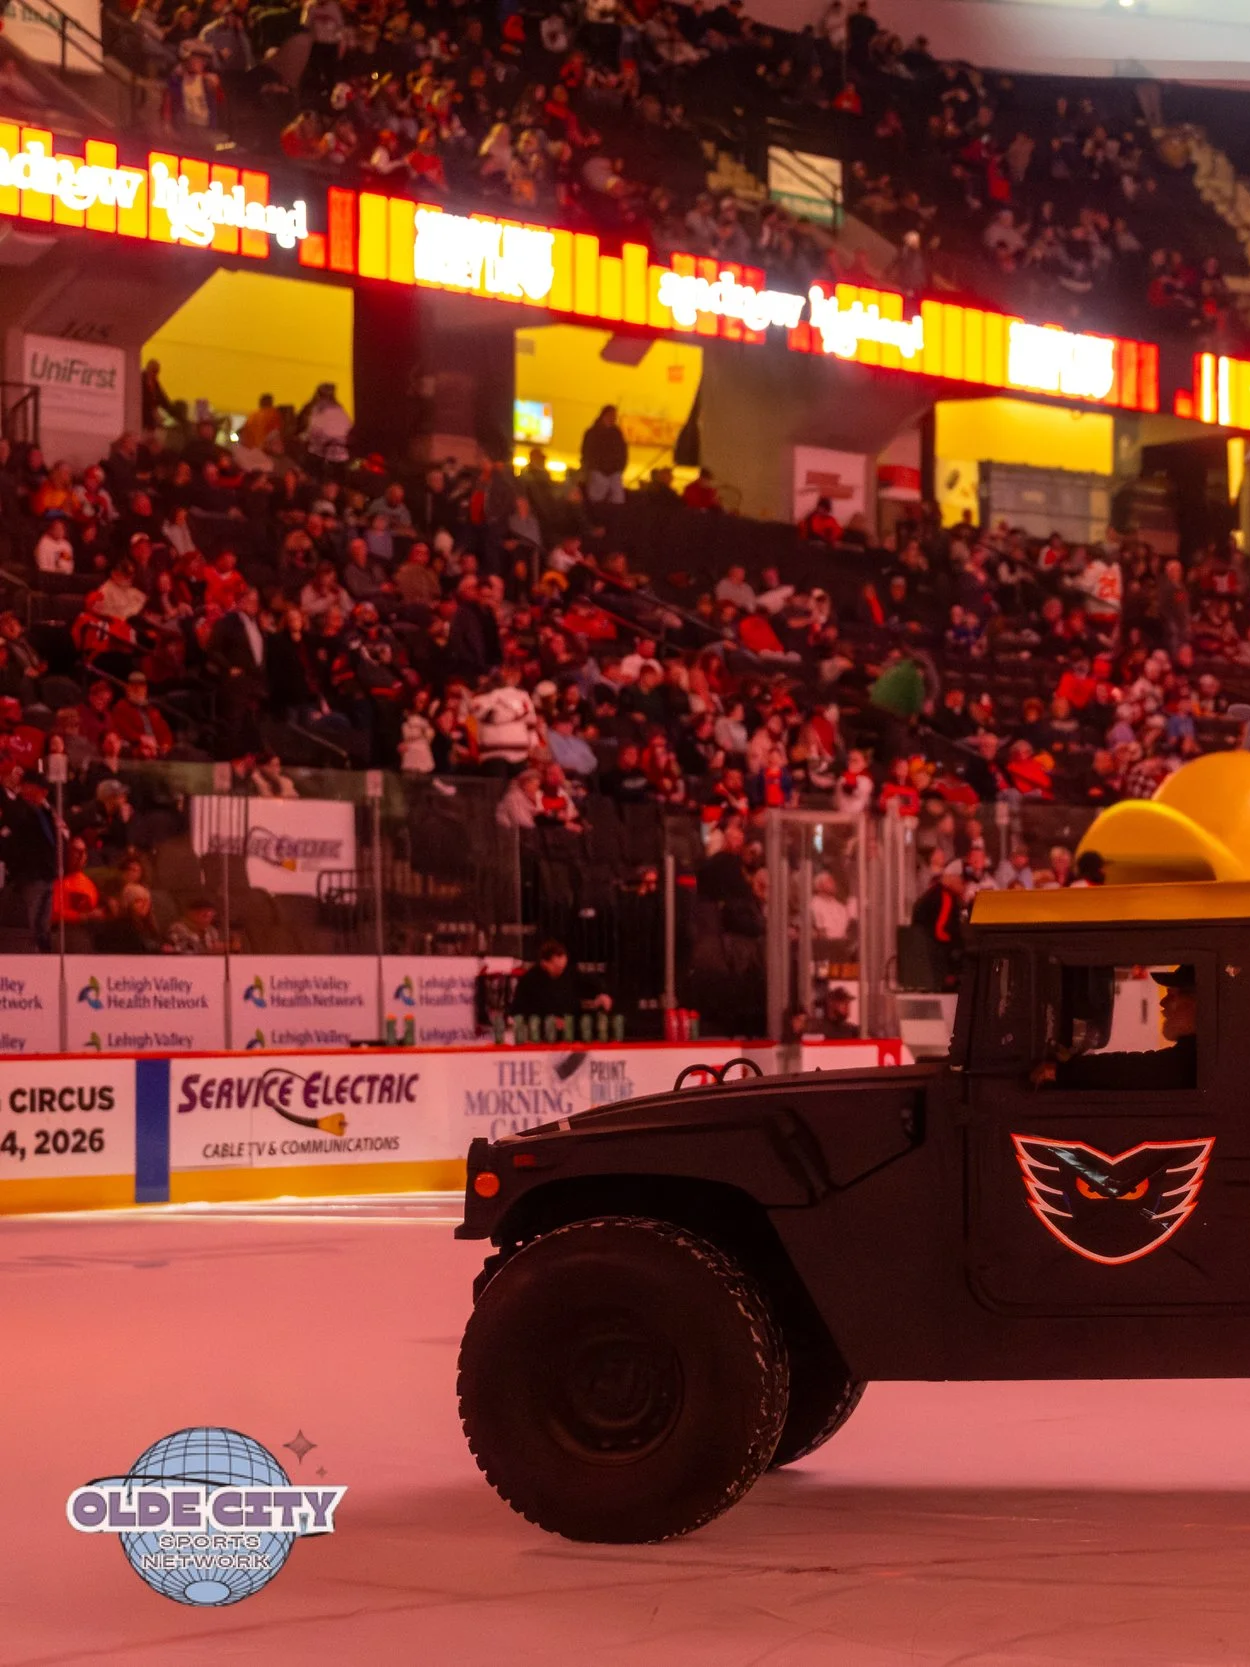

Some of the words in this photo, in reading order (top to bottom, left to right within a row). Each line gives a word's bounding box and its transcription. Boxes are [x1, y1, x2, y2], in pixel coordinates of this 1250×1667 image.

[30, 351, 116, 389] UniFirst
[107, 976, 152, 992] Lehigh
[153, 977, 193, 993] Valley
[270, 975, 313, 991] Lehigh
[314, 976, 350, 992] Valley
[0, 995, 43, 1010] twork
[107, 995, 151, 1010] Health
[153, 995, 209, 1010] Network
[270, 993, 313, 1008] Health
[313, 994, 364, 1008] Network
[0, 1032, 26, 1051] lley
[107, 1032, 152, 1048] Lehigh
[154, 1032, 193, 1049] Valley
[270, 1028, 313, 1045] Lehigh
[314, 1028, 351, 1045] Valley
[494, 1059, 543, 1088] THE
[8, 1085, 115, 1114] CIRCUS
[176, 1073, 294, 1114] SERVICE
[303, 1071, 420, 1109] ELECTRIC
[463, 1087, 574, 1117] MORNING
[34, 1128, 105, 1156] 2026
[203, 1141, 248, 1159] CABLE
[249, 1141, 265, 1158] TV
[267, 1141, 277, 1157] &
[280, 1136, 400, 1156] COMMUNICATIONS
